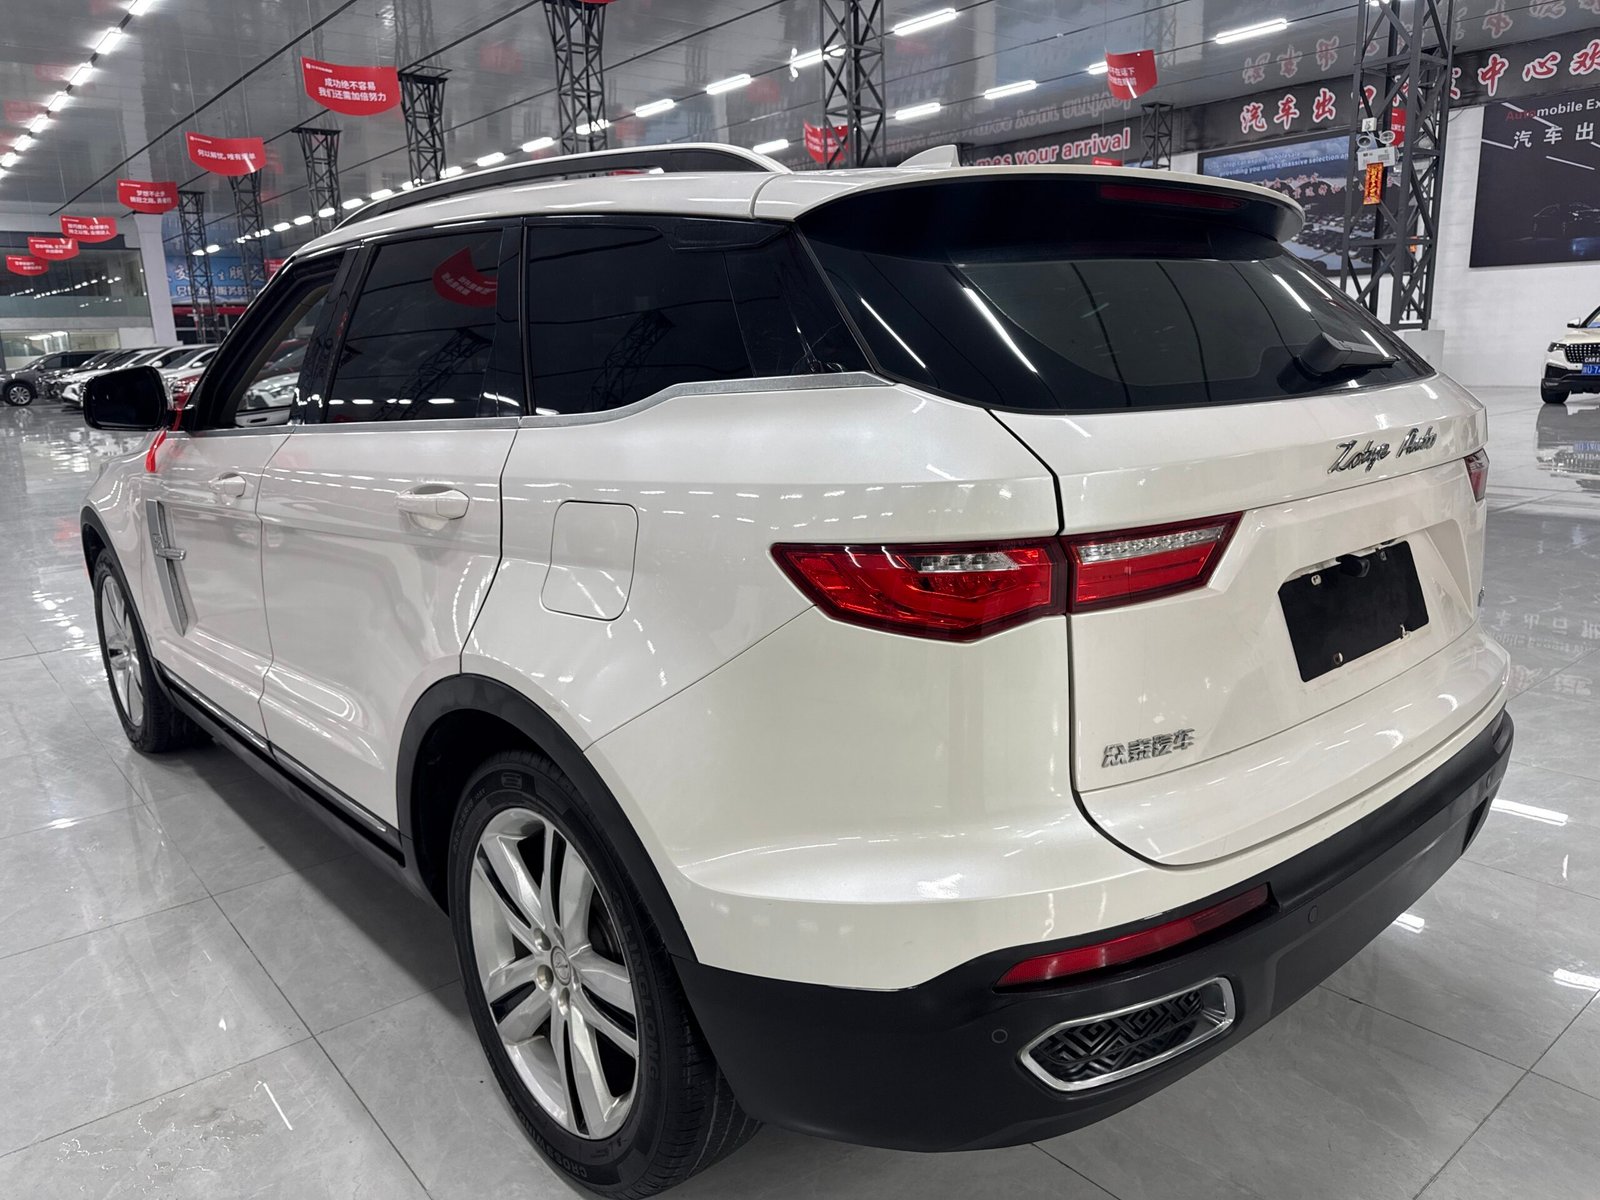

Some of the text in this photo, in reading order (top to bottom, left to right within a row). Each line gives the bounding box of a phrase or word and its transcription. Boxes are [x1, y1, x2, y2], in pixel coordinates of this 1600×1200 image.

[318, 87, 387, 102] 我们还需加倍努力
[324, 78, 376, 91] 成功绝不容易
[1016, 145, 1059, 165] your
[1062, 127, 1131, 160] arrival
[1513, 122, 1594, 149] 汽车出
[1219, 167, 1248, 177] providing
[1249, 165, 1261, 174] you
[1262, 163, 1276, 172] with
[1281, 159, 1308, 168] massive
[1309, 154, 1340, 165] selection
[1101, 728, 1195, 768] 众泰汽车
[622, 922, 660, 1082] LINGLONG
